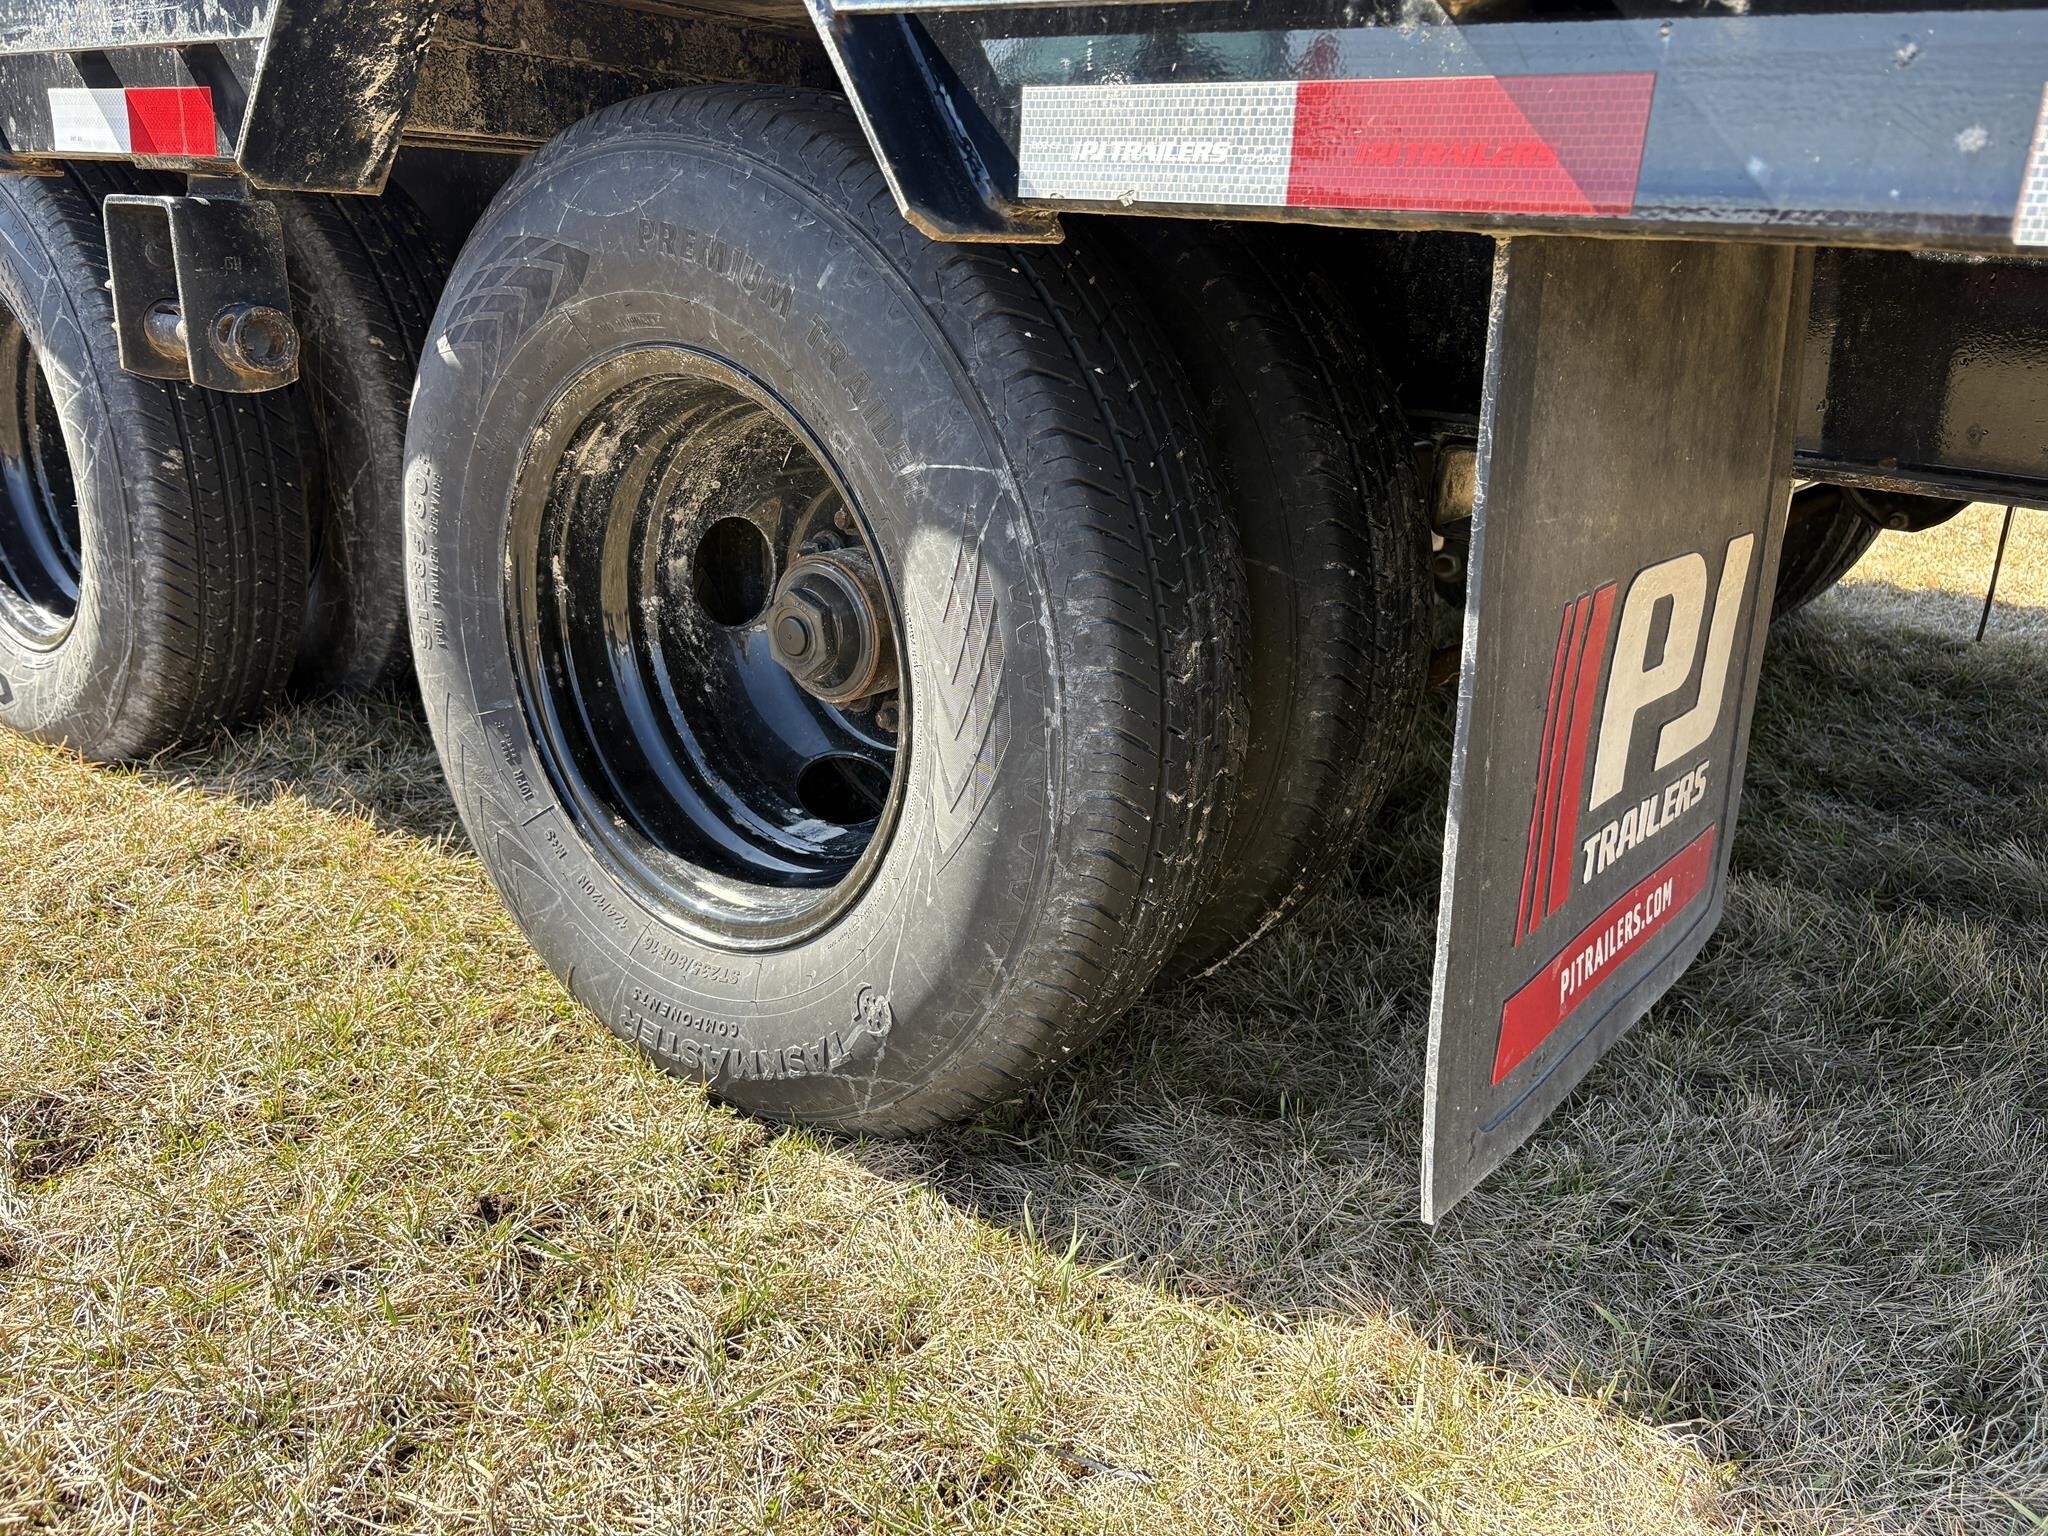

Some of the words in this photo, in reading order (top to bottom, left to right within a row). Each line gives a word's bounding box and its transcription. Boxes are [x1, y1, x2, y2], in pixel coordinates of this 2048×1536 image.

[1109, 142, 1230, 164] TRAILERS
[1403, 143, 1558, 169] TRAILERS
[637, 218, 796, 321] PREMIUM
[429, 472, 444, 536] SERVICE
[1588, 533, 1756, 812] PJ
[1582, 760, 1711, 885] TRAILERS
[640, 936, 742, 985] ST235/80R16
[1559, 876, 1674, 1005] PJTRAILERS.COM
[619, 1004, 856, 1081] TASKMASTER
[631, 990, 740, 1038] COMPONENTS
